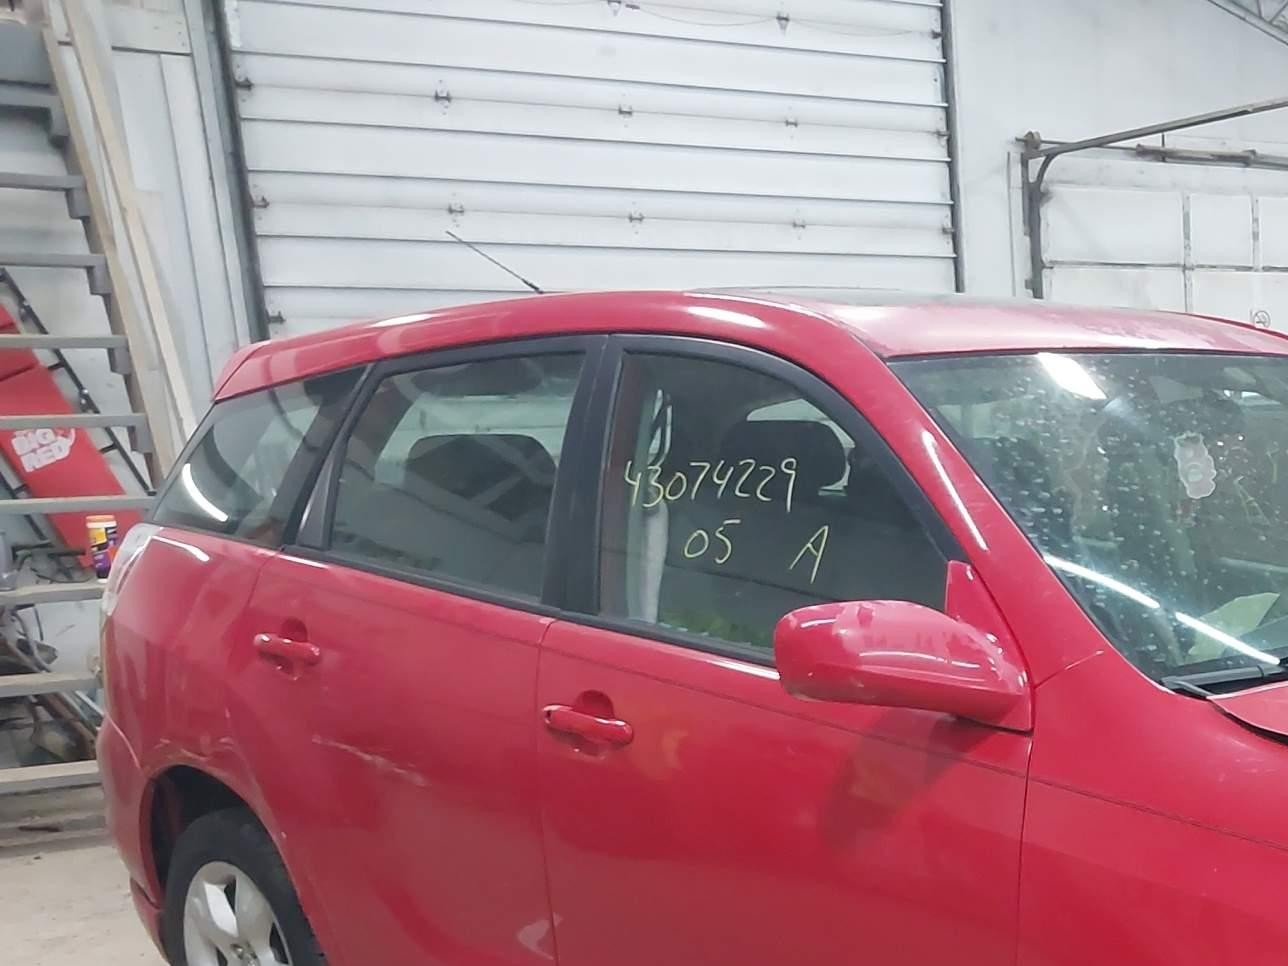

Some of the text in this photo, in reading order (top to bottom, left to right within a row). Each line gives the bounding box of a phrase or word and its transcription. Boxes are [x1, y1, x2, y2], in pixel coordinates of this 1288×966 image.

[624, 458, 796, 512] 43074229
[684, 519, 829, 583] 05 A
